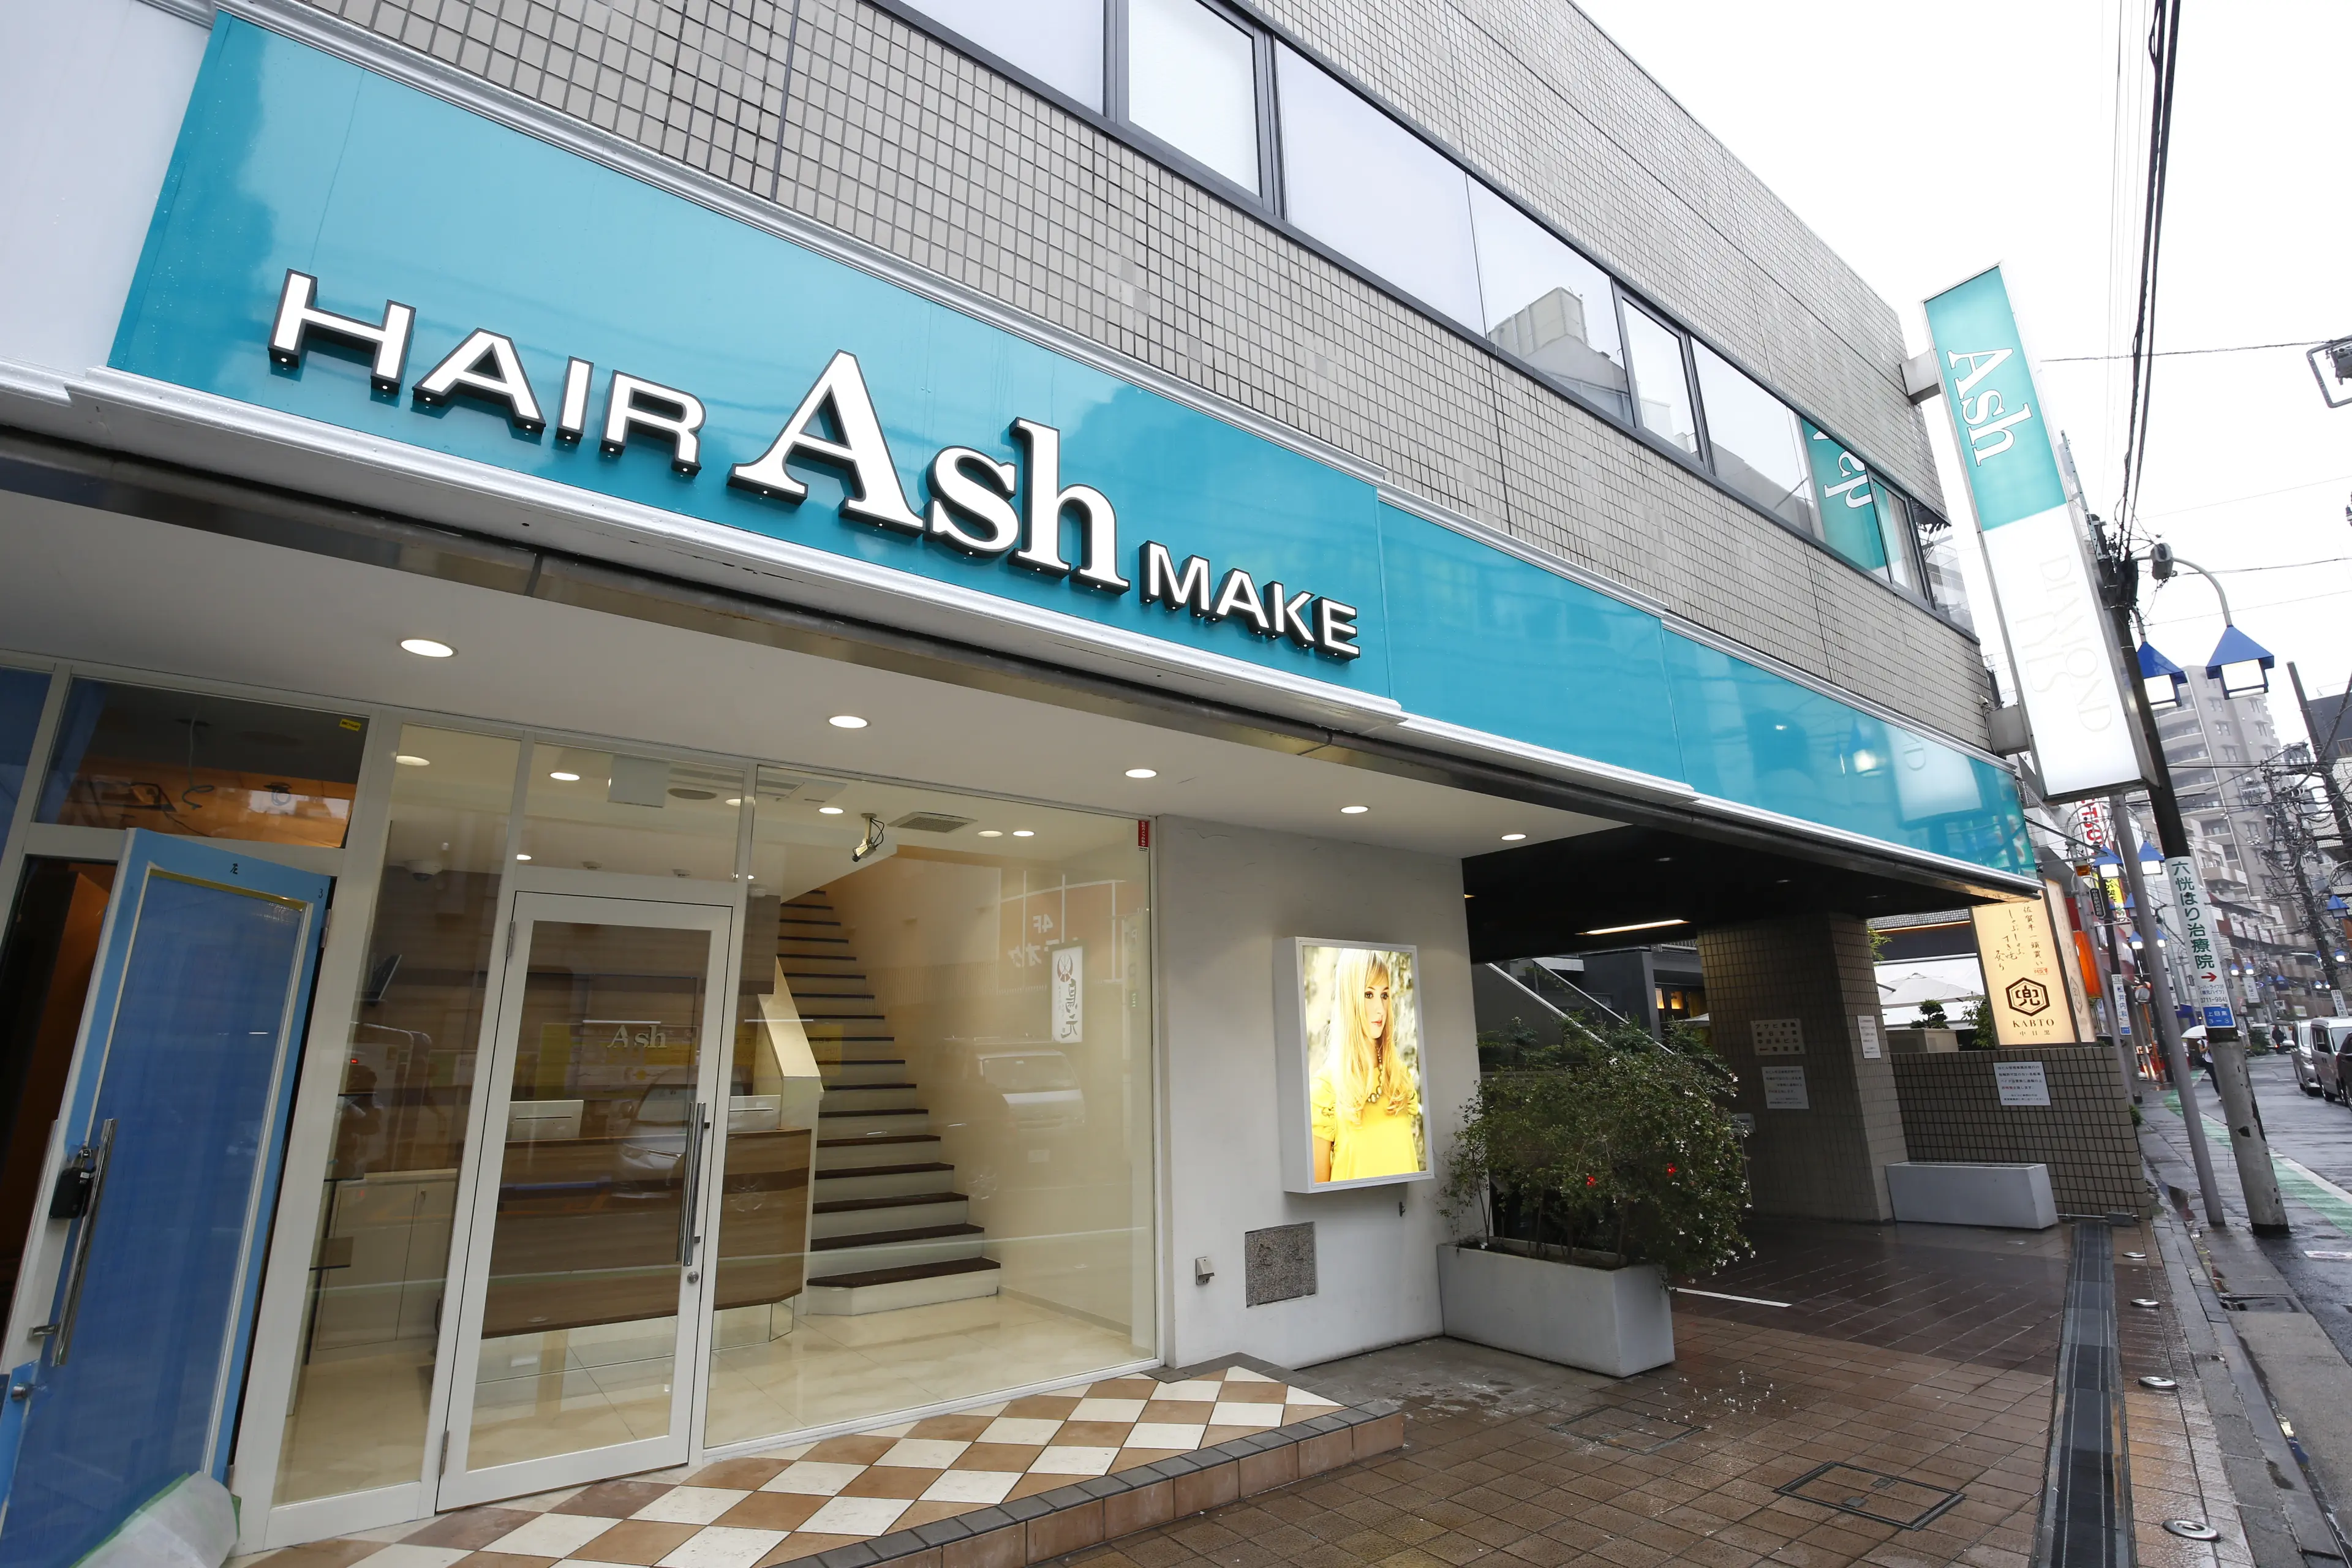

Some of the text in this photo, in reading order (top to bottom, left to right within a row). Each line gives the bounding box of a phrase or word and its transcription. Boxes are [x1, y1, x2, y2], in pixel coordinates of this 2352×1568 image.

[1947, 348, 2032, 467] Ash
[268, 268, 1360, 660] HAIR Ash MAKE
[608, 1025, 667, 1049] Ash
[2013, 1019, 2054, 1028] KABTO
